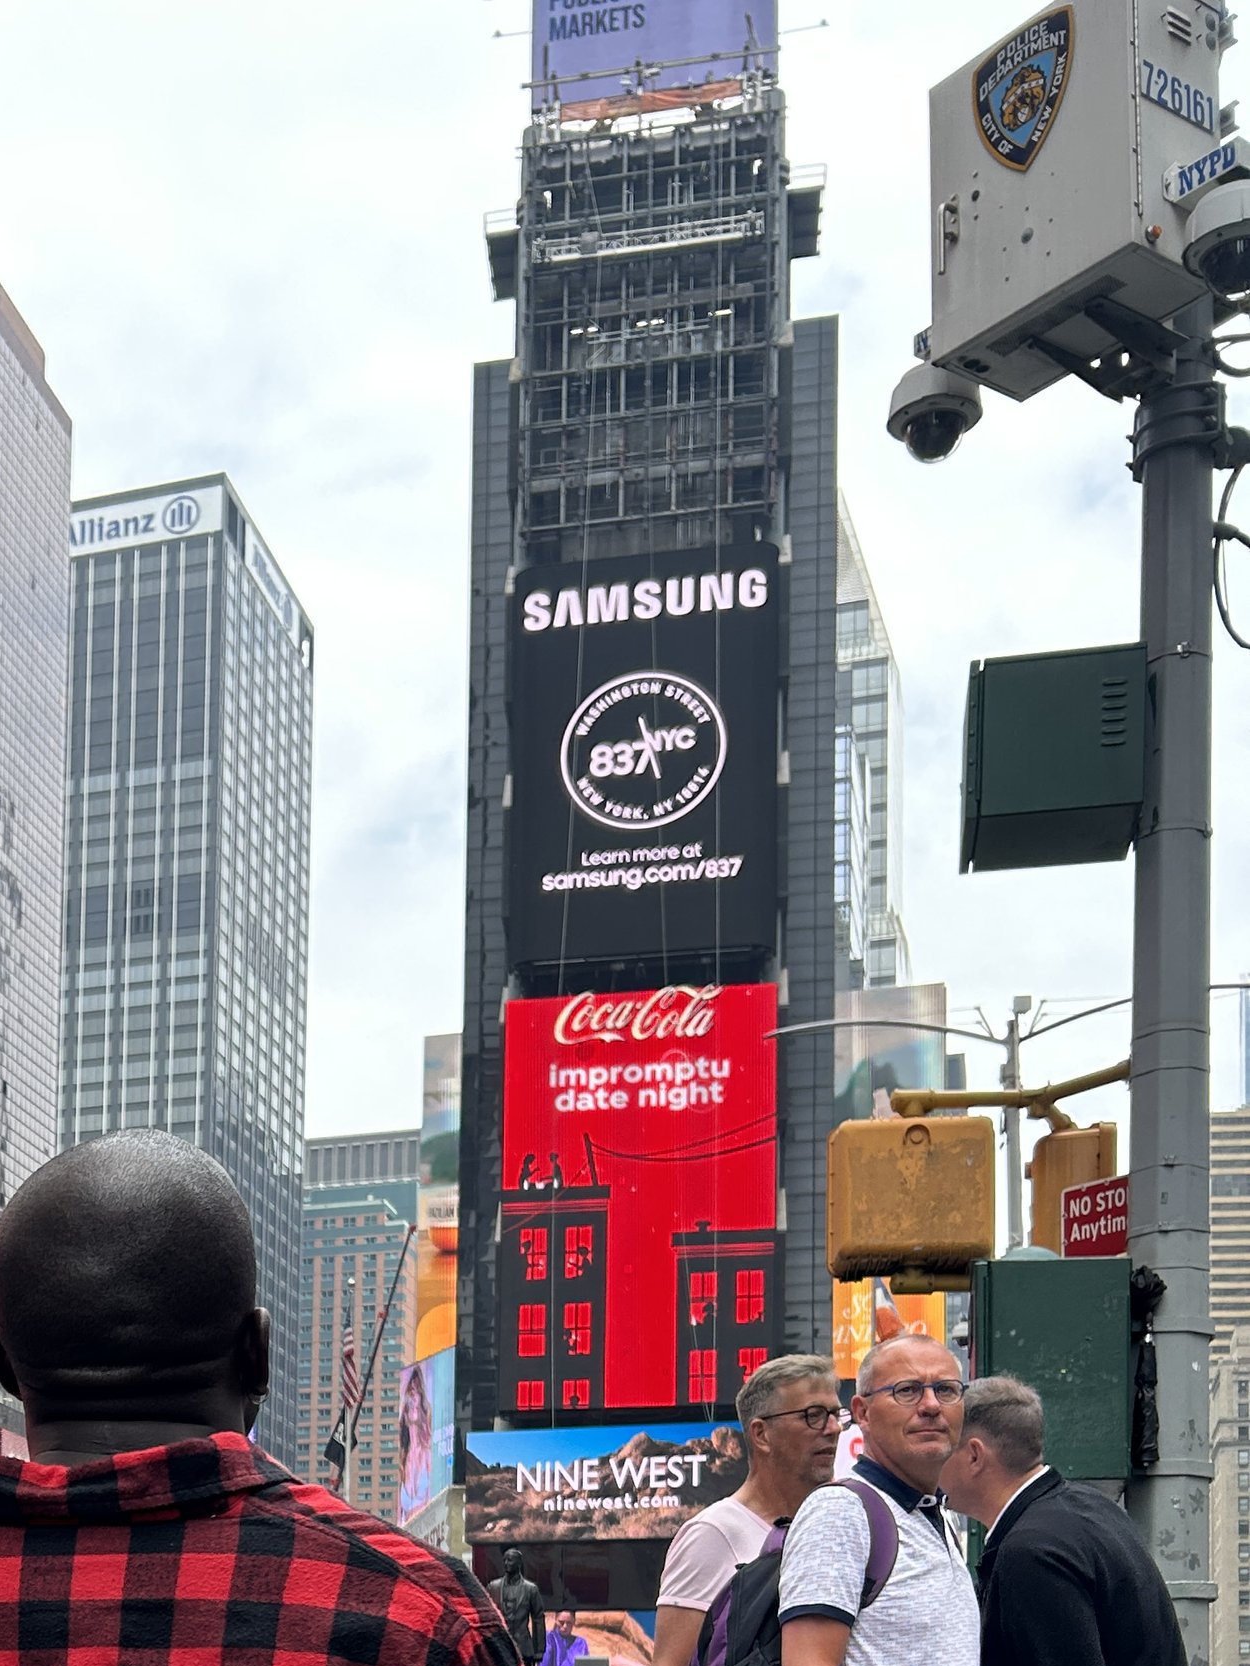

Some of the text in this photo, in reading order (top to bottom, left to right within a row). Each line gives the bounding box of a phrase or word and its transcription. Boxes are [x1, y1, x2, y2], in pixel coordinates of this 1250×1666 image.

[549, 4, 645, 42] MARKETS
[996, 20, 1049, 68] POLICE
[979, 30, 1067, 102] DEPARTMENT
[981, 51, 1068, 155] CITY OF NEW YORK
[1178, 140, 1237, 197] NYPD
[522, 568, 769, 632] SAMSUNG
[576, 681, 712, 737] WASHINGTON STREET
[577, 776, 604, 806] NEW
[653, 799, 674, 818] NY
[541, 855, 744, 892] samsung.com/837
[581, 843, 703, 867] Learn more at
[553, 983, 724, 1047] Coca-Cola
[549, 1055, 731, 1091] impromptu
[555, 1081, 725, 1114] date night
[1069, 1188, 1128, 1218] NO STO
[1070, 1214, 1128, 1244] Anytim
[516, 1453, 709, 1494] NINE WEST
[543, 1491, 680, 1514] ninewest.com
